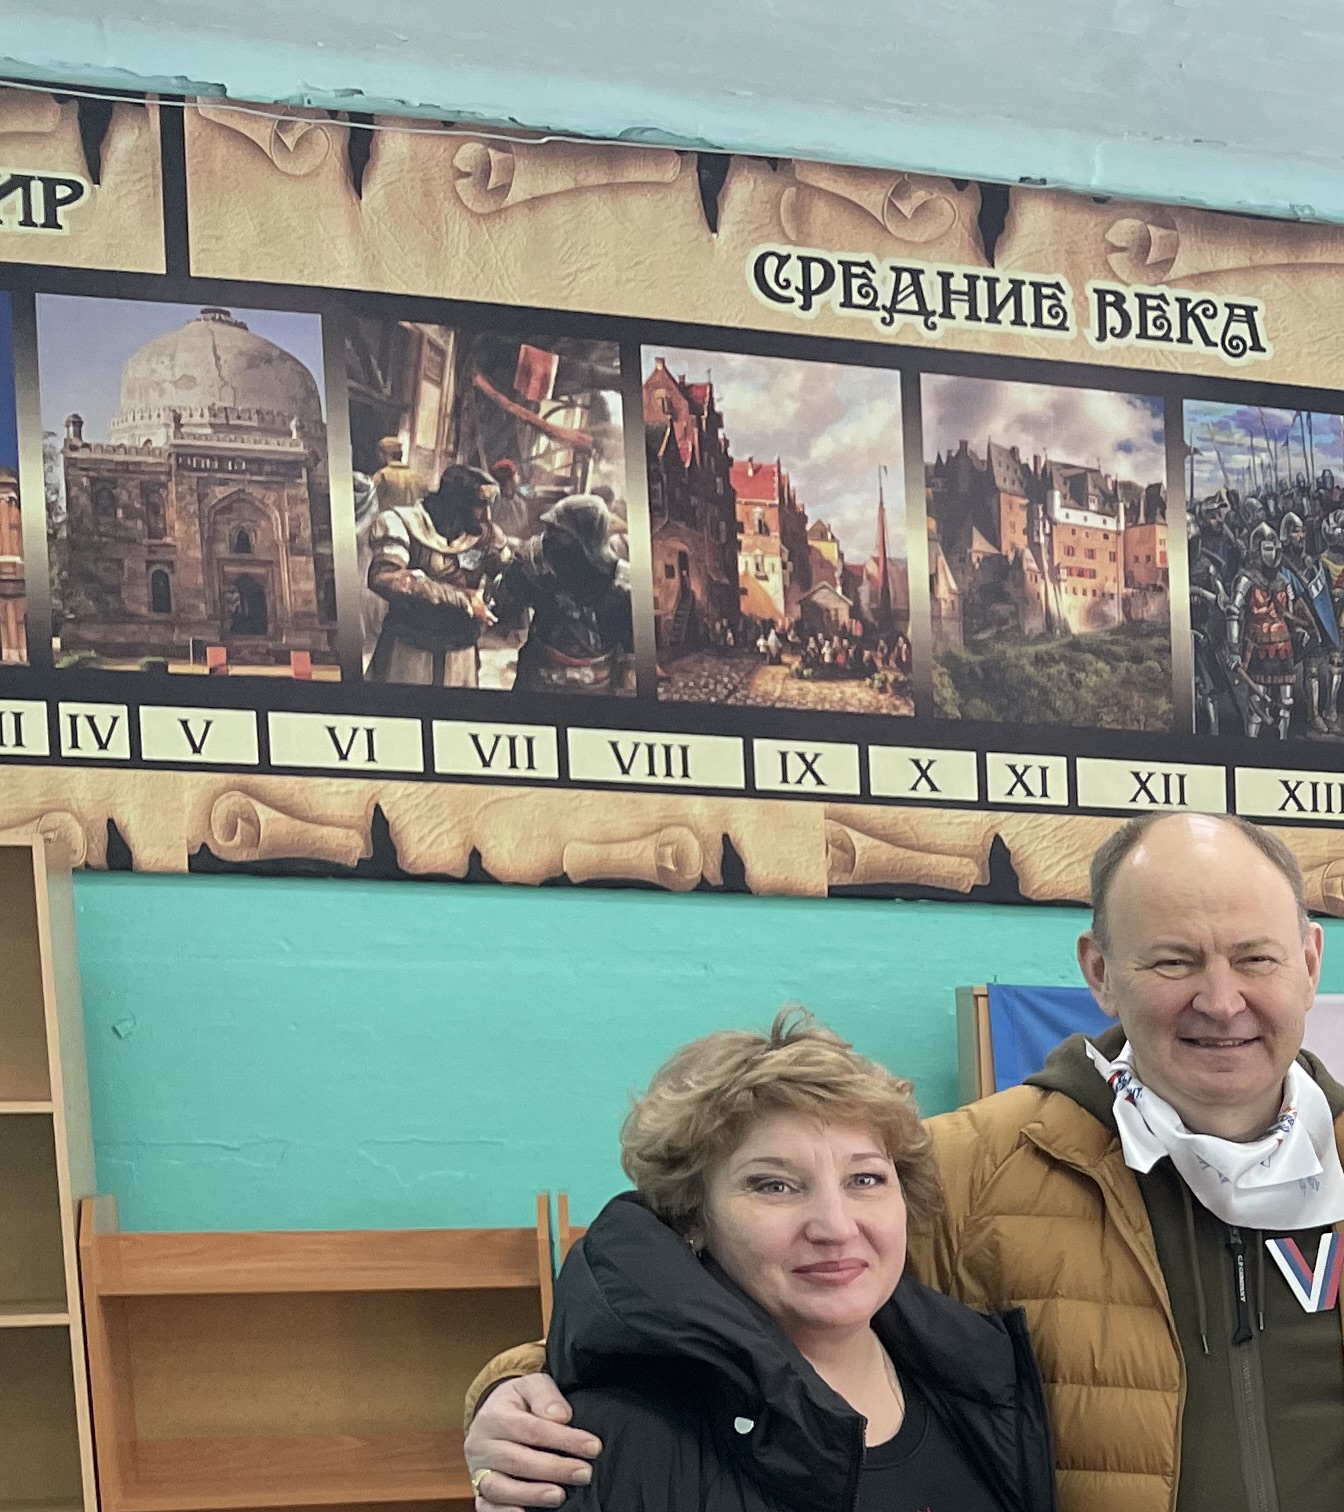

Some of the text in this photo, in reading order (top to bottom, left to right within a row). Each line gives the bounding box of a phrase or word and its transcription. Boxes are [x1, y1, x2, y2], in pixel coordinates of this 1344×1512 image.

[0, 174, 84, 230] ИР
[753, 250, 1267, 358] СРЕДНИЕ ВЕКА
[67, 714, 120, 751] IV
[177, 718, 213, 756] V
[326, 725, 378, 763] VI
[469, 732, 537, 771] VII
[608, 740, 691, 779] VIII
[777, 750, 828, 787] IX
[909, 757, 942, 794] X
[1004, 763, 1051, 799] XI
[1129, 770, 1188, 806] XII
